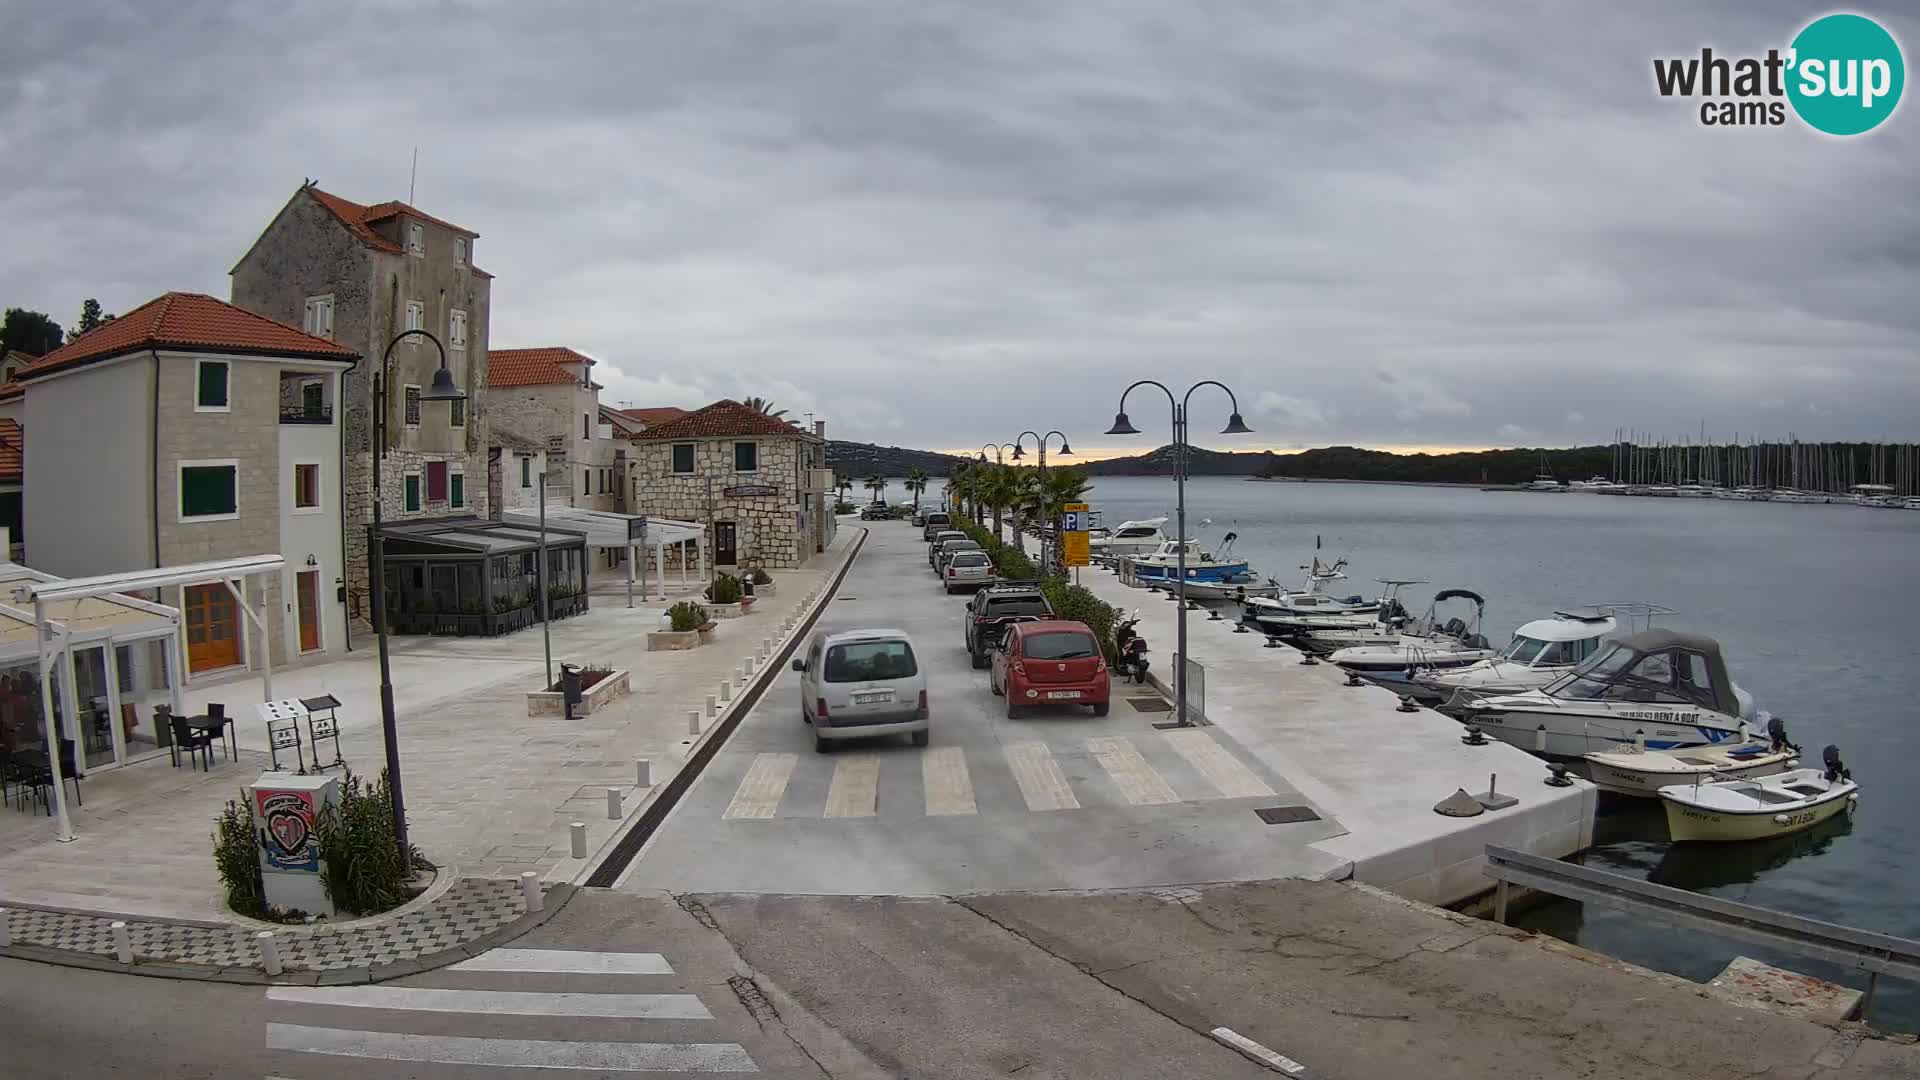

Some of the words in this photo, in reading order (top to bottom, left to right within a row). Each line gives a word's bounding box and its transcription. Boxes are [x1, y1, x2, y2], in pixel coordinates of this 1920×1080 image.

[1066, 513, 1076, 529] P
[1654, 712, 1674, 721] RENT
[1674, 712, 1680, 722] A
[1680, 712, 1700, 724] BOAT
